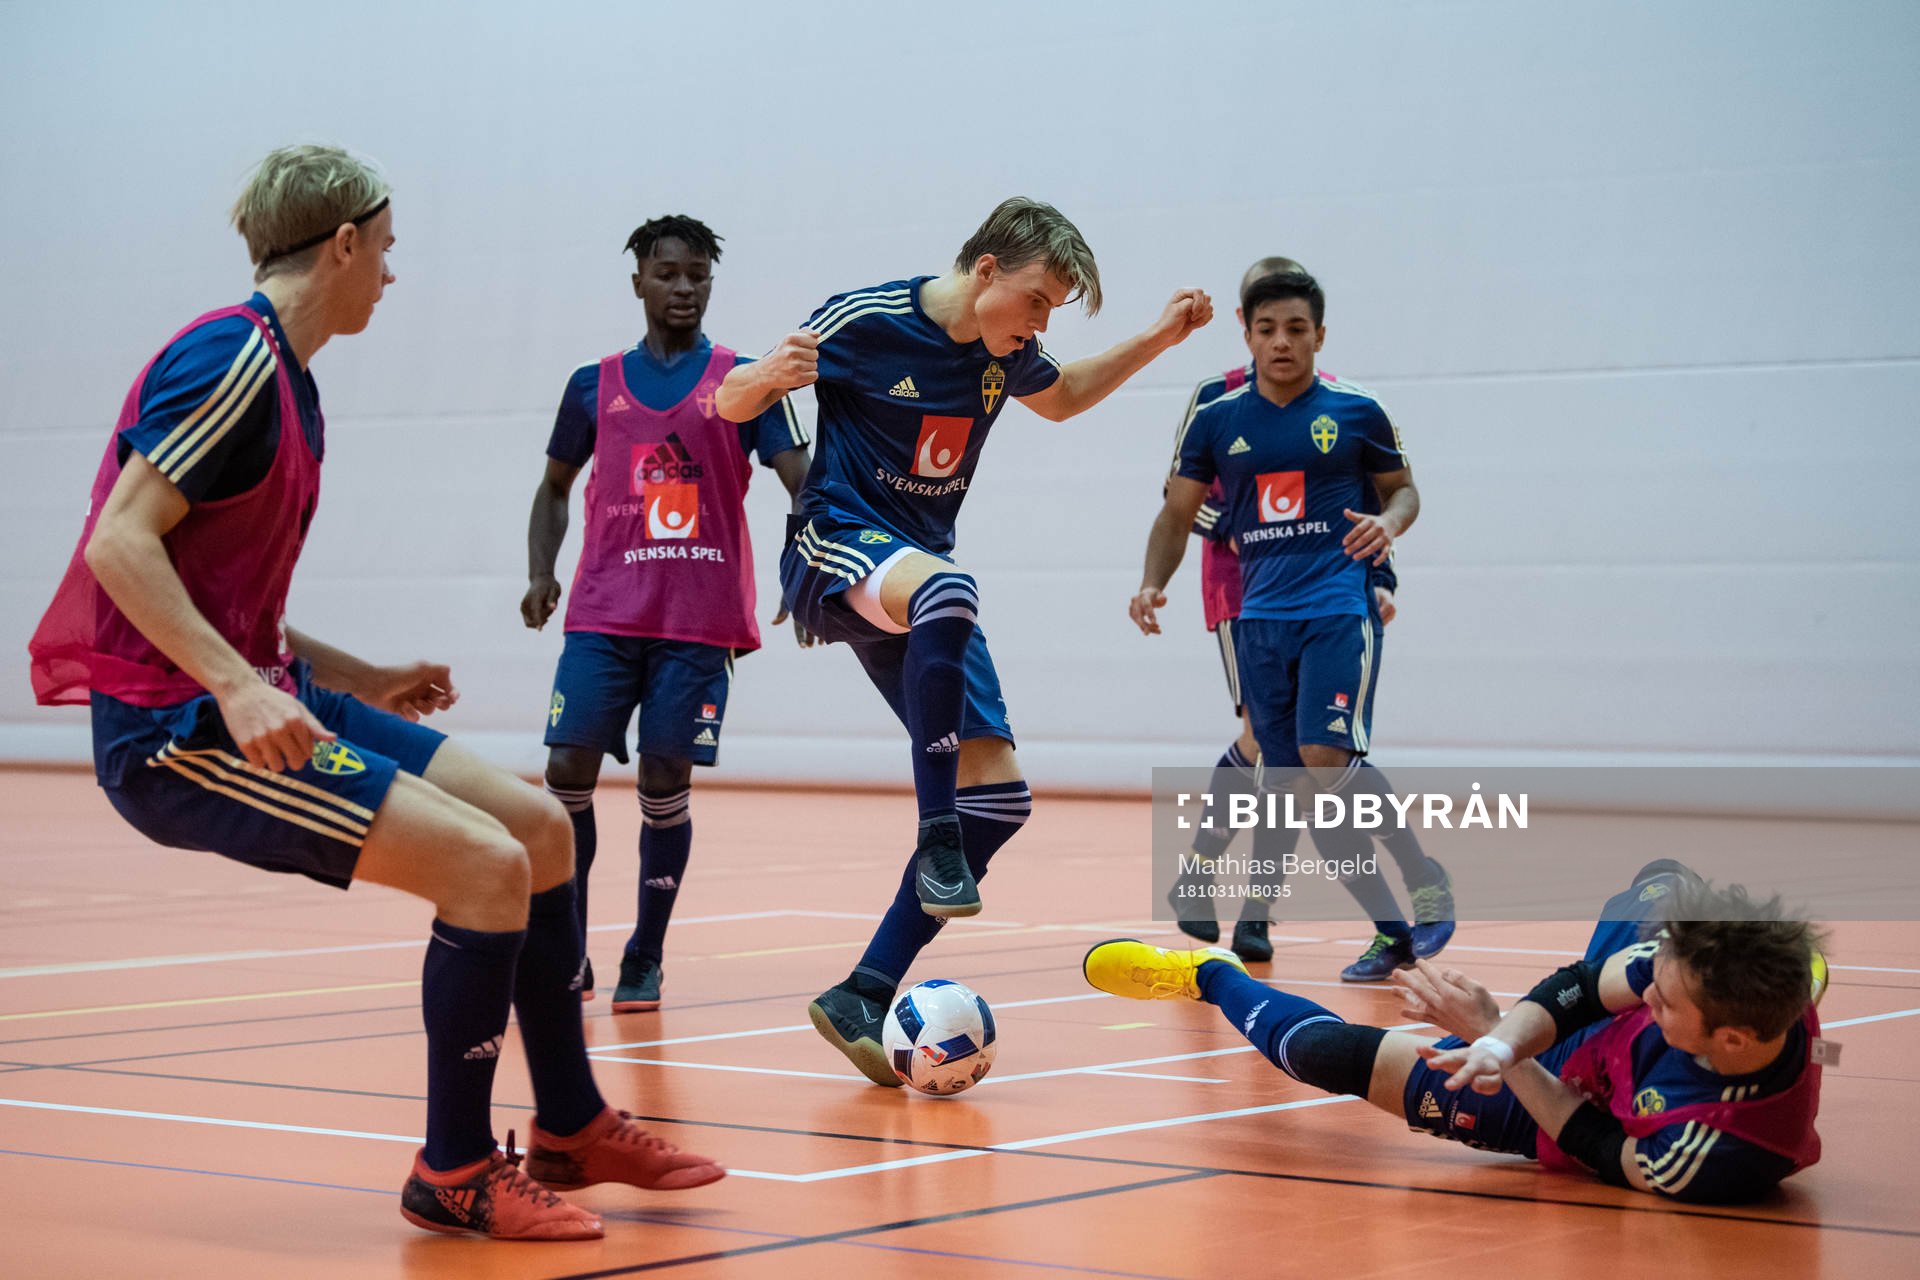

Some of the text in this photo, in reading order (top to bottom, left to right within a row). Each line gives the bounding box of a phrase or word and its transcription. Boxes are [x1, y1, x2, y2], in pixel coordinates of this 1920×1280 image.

[889, 388, 920, 398] adidas
[637, 462, 704, 480] adidas
[876, 467, 968, 497] SVENSKA SPEL
[606, 503, 645, 518] SVENS
[1243, 521, 1331, 544] SVENSKA SPEL
[624, 546, 725, 564] SVENSKA SPEL
